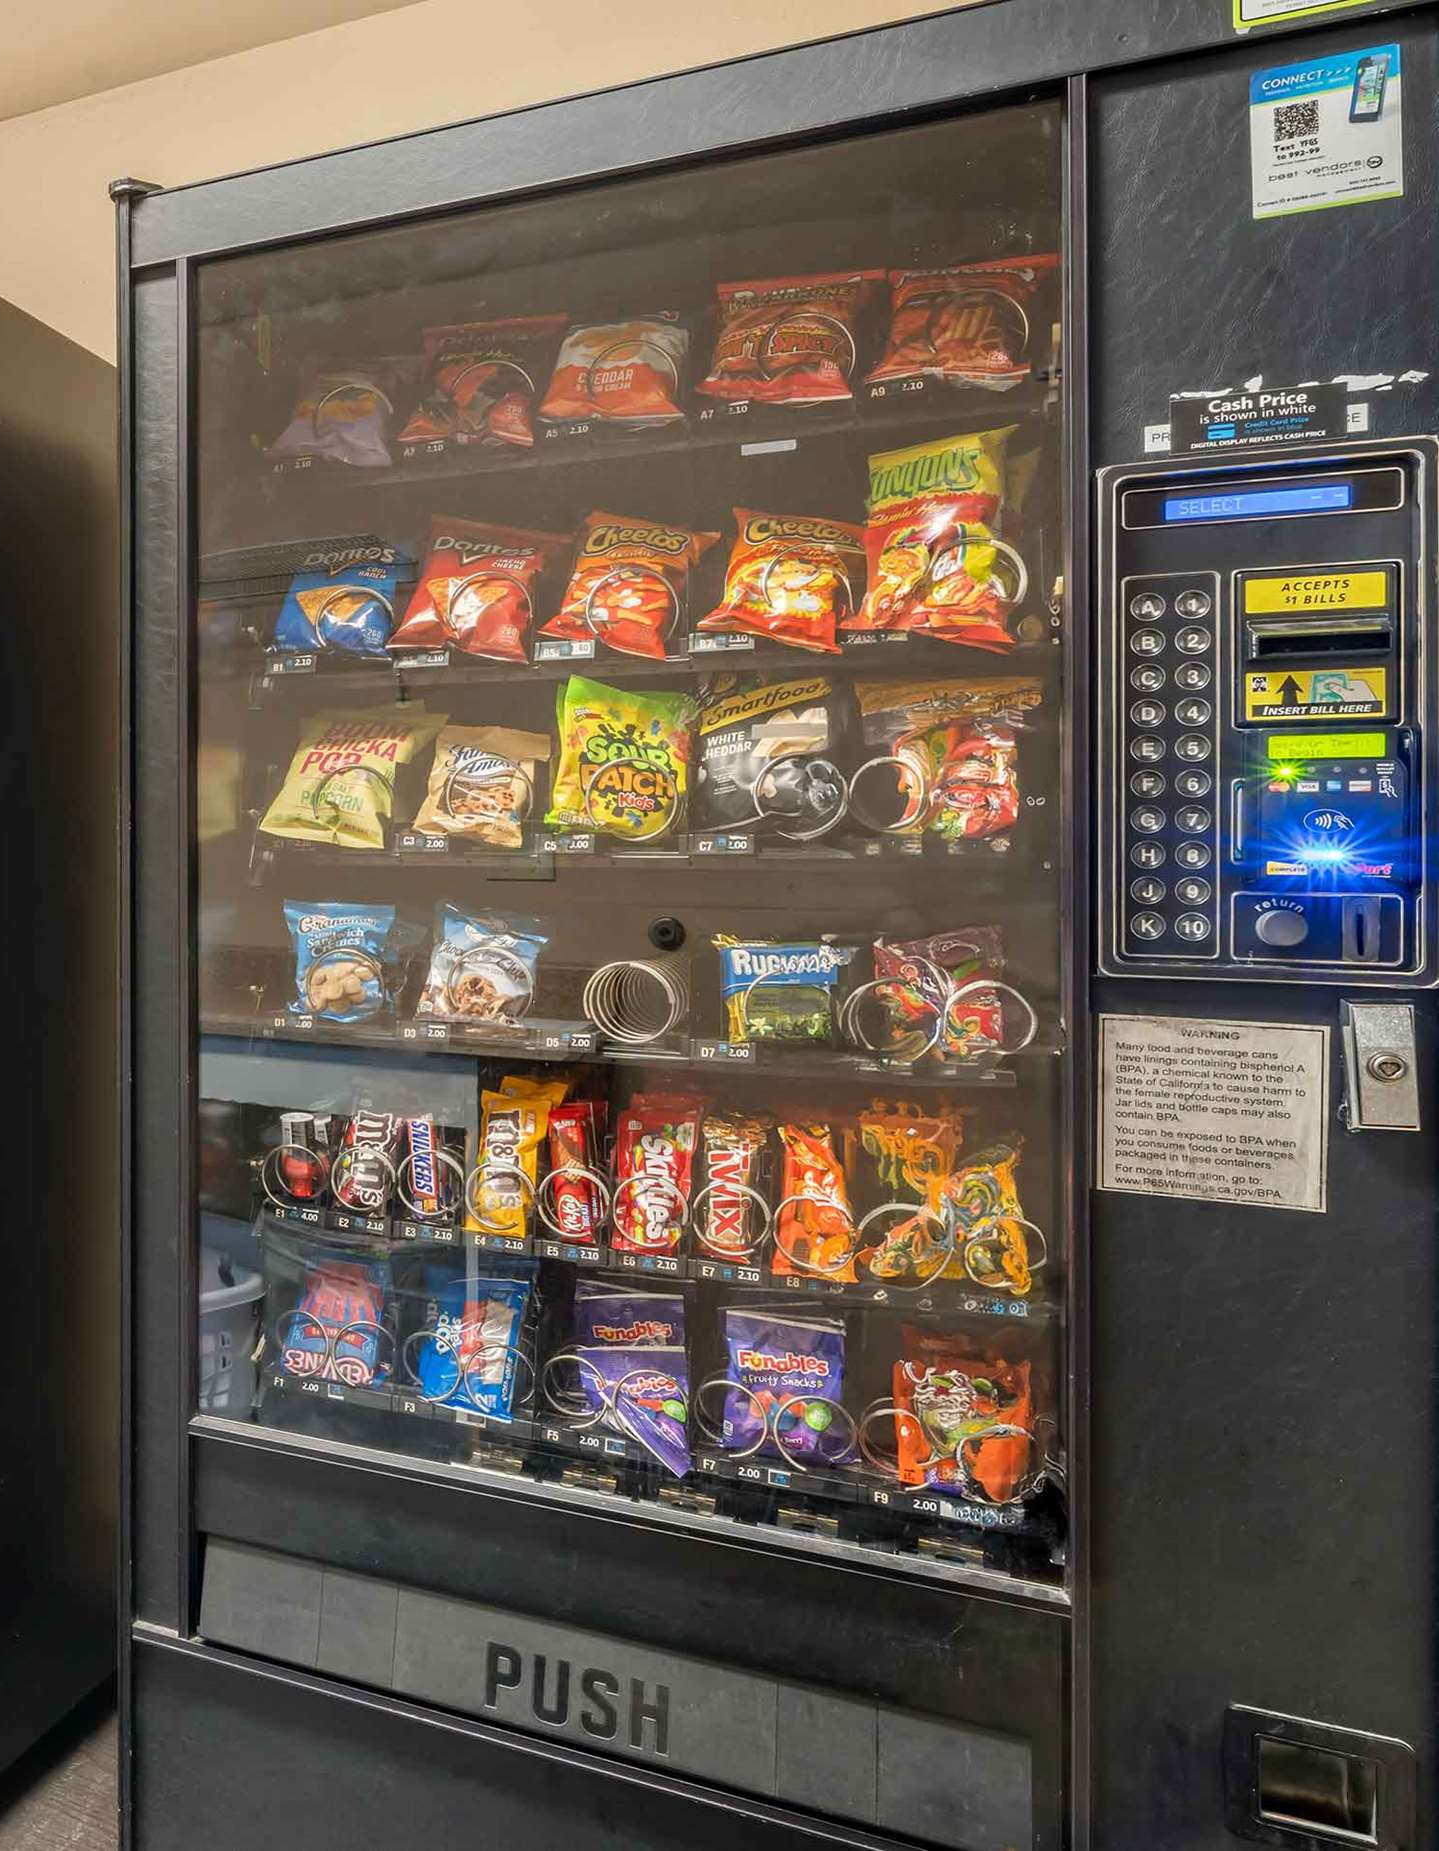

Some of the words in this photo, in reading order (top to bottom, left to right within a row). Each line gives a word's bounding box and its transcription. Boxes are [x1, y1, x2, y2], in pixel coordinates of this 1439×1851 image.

[1262, 69, 1324, 91] CONNECT
[1273, 144, 1295, 152] Text
[1277, 153, 1287, 161] to
[1268, 171, 1299, 182] best
[1305, 160, 1361, 177] vendors
[871, 386, 886, 398] A9
[1209, 396, 1252, 413] Cash
[1260, 392, 1307, 407] Price
[700, 409, 714, 420] A7
[1200, 414, 1210, 424] is
[1214, 410, 1257, 423] shown
[1262, 408, 1274, 417] in
[1279, 404, 1317, 415] white
[1249, 435, 1283, 443] REFLECTS
[1284, 432, 1304, 440] CASH
[1305, 430, 1326, 438] PRICE
[1178, 497, 1243, 516] SELECT
[586, 524, 683, 553] Cheetos
[432, 536, 536, 556] Doritos
[306, 546, 395, 566] Doritos
[1281, 578, 1350, 592] ACCEPTS
[1187, 598, 1197, 611] 1
[1285, 596, 1297, 605] $1
[1303, 592, 1346, 603] BILLS
[1142, 600, 1155, 613] A
[1142, 636, 1155, 649] B
[1187, 633, 1199, 647] 2
[294, 657, 312, 667] 2.10
[1141, 671, 1155, 684] C
[1187, 669, 1198, 683] 3
[706, 680, 827, 726] Smartfood
[1262, 705, 1307, 716] INSERT
[1309, 704, 1336, 715] BILL
[1339, 704, 1373, 713] HERE
[1142, 706, 1155, 720] D
[1187, 705, 1199, 719] 4
[707, 730, 746, 747] WHITE
[313, 739, 397, 761] CHICKA
[586, 735, 671, 771] SOUR
[1142, 741, 1155, 755] E
[1187, 740, 1198, 756] 5
[580, 763, 677, 799] PATCH
[1142, 777, 1155, 791] F
[1187, 777, 1198, 792] 6
[617, 791, 656, 810] Kids
[1140, 813, 1155, 827] G
[1187, 813, 1198, 826] 7
[403, 836, 415, 846] C3
[426, 839, 444, 849] 2.00
[544, 840, 557, 851] C5
[700, 841, 712, 852] C7
[1142, 849, 1155, 862] H
[1187, 848, 1198, 862] 8
[1142, 884, 1153, 897] J
[1187, 885, 1198, 899] 9
[1254, 898, 1304, 913] return
[1142, 919, 1155, 933] K
[1182, 920, 1203, 934] 10
[274, 1017, 285, 1027] D1
[404, 1028, 416, 1039] D3
[427, 1028, 446, 1038] 2.00
[1180, 1028, 1240, 1040] WARNING
[545, 1037, 560, 1048] D5
[571, 1038, 590, 1048] 2.00
[701, 1047, 716, 1058] D7
[1116, 1042, 1144, 1052] Many
[1148, 1044, 1170, 1053] food
[1197, 1047, 1248, 1058] beverage
[1252, 1051, 1278, 1059] cans
[1116, 1076, 1142, 1085] State
[1160, 1079, 1209, 1090] California
[1227, 1084, 1260, 1093] cause
[1263, 1086, 1292, 1095] harm
[1296, 1089, 1306, 1097] to
[1116, 1125, 1134, 1134] You
[1161, 1129, 1173, 1137] be
[1177, 1131, 1222, 1142] exposed
[1226, 1134, 1236, 1143] to
[1240, 1135, 1263, 1145] BPA
[1266, 1138, 1296, 1148] when
[411, 1120, 433, 1194] SNICKERS
[1115, 1164, 1133, 1173] For
[1136, 1166, 1162, 1175] more
[1249, 1176, 1262, 1185] to:
[641, 1134, 677, 1240] Skittles
[275, 1208, 285, 1219] E1
[300, 1211, 319, 1222] 4.00
[338, 1217, 350, 1228] E2
[366, 1220, 384, 1231] 2.10
[405, 1226, 417, 1238] E3
[433, 1230, 453, 1241] 2.10
[474, 1235, 486, 1246] E4
[504, 1239, 524, 1250] 2.10
[546, 1245, 559, 1257] E5
[580, 1249, 600, 1261] 2.10
[623, 1255, 636, 1267] E6
[656, 1259, 678, 1271] 2.10
[702, 1265, 715, 1278] E7
[737, 1270, 760, 1282] 2.10
[786, 1276, 800, 1288] E8
[737, 1350, 830, 1377] Funables
[273, 1375, 285, 1387] F1
[302, 1382, 319, 1393] 2.00
[749, 1374, 777, 1386] Fruity
[780, 1375, 817, 1389] Snacks
[404, 1402, 416, 1414] F3
[546, 1429, 560, 1442] F5
[579, 1435, 599, 1448] 2.00
[703, 1458, 717, 1471] F7
[738, 1466, 760, 1479] 2.00
[873, 1490, 889, 1504] F9
[912, 1499, 938, 1512] 2.00
[484, 1639, 671, 1758] PUSH
